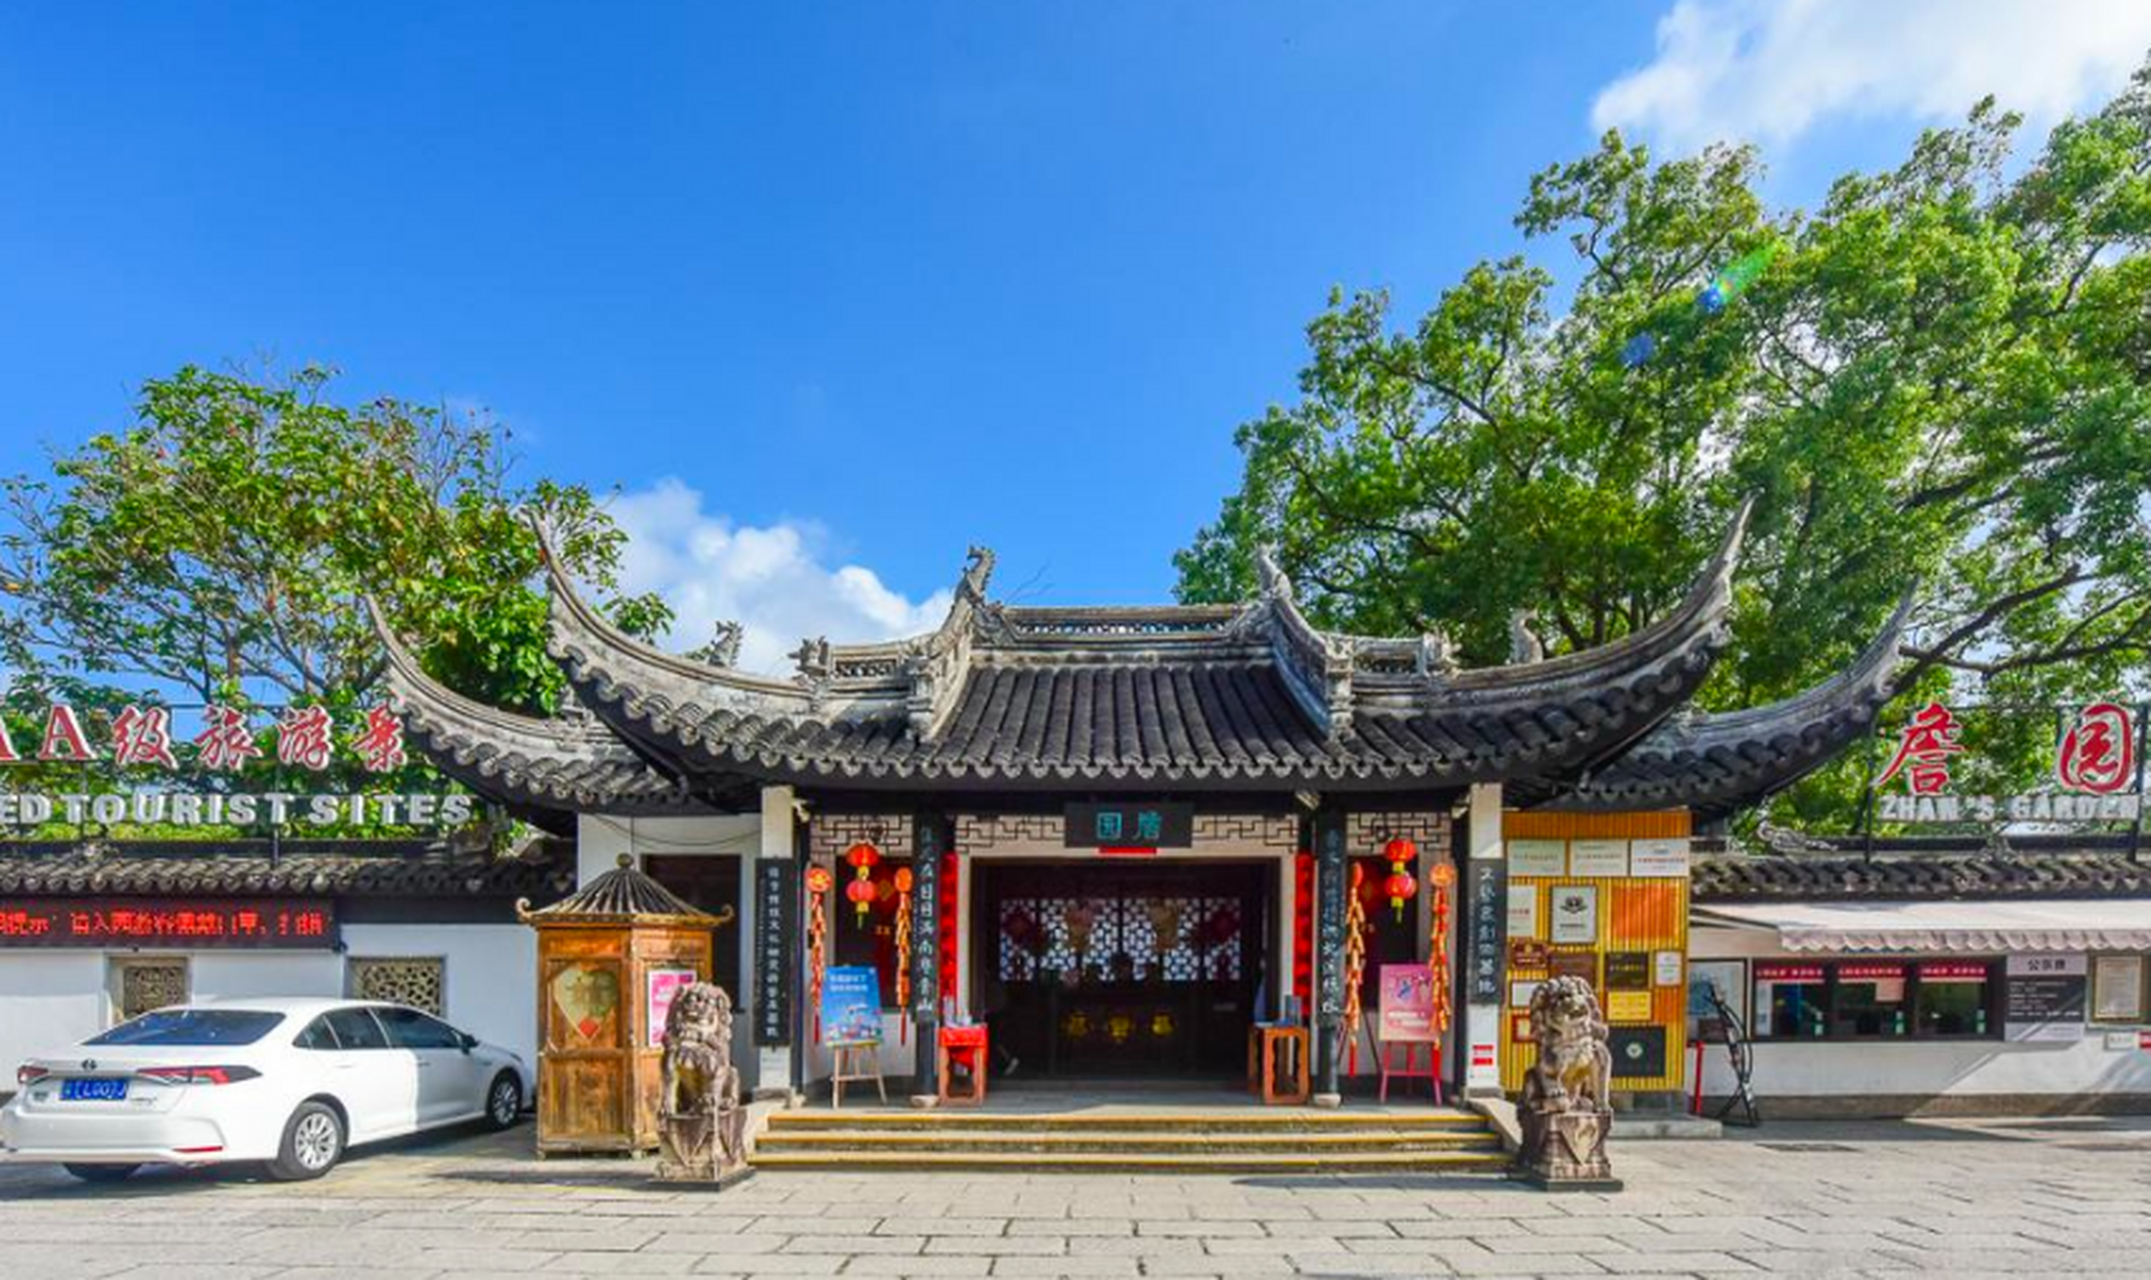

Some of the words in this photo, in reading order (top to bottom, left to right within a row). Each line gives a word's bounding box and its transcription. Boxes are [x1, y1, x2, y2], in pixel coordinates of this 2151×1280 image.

[1878, 702, 2133, 795] 詹园
[61, 792, 294, 825] TOURIST
[308, 793, 471, 825] SITES
[2009, 794, 2140, 822] GARDEN
